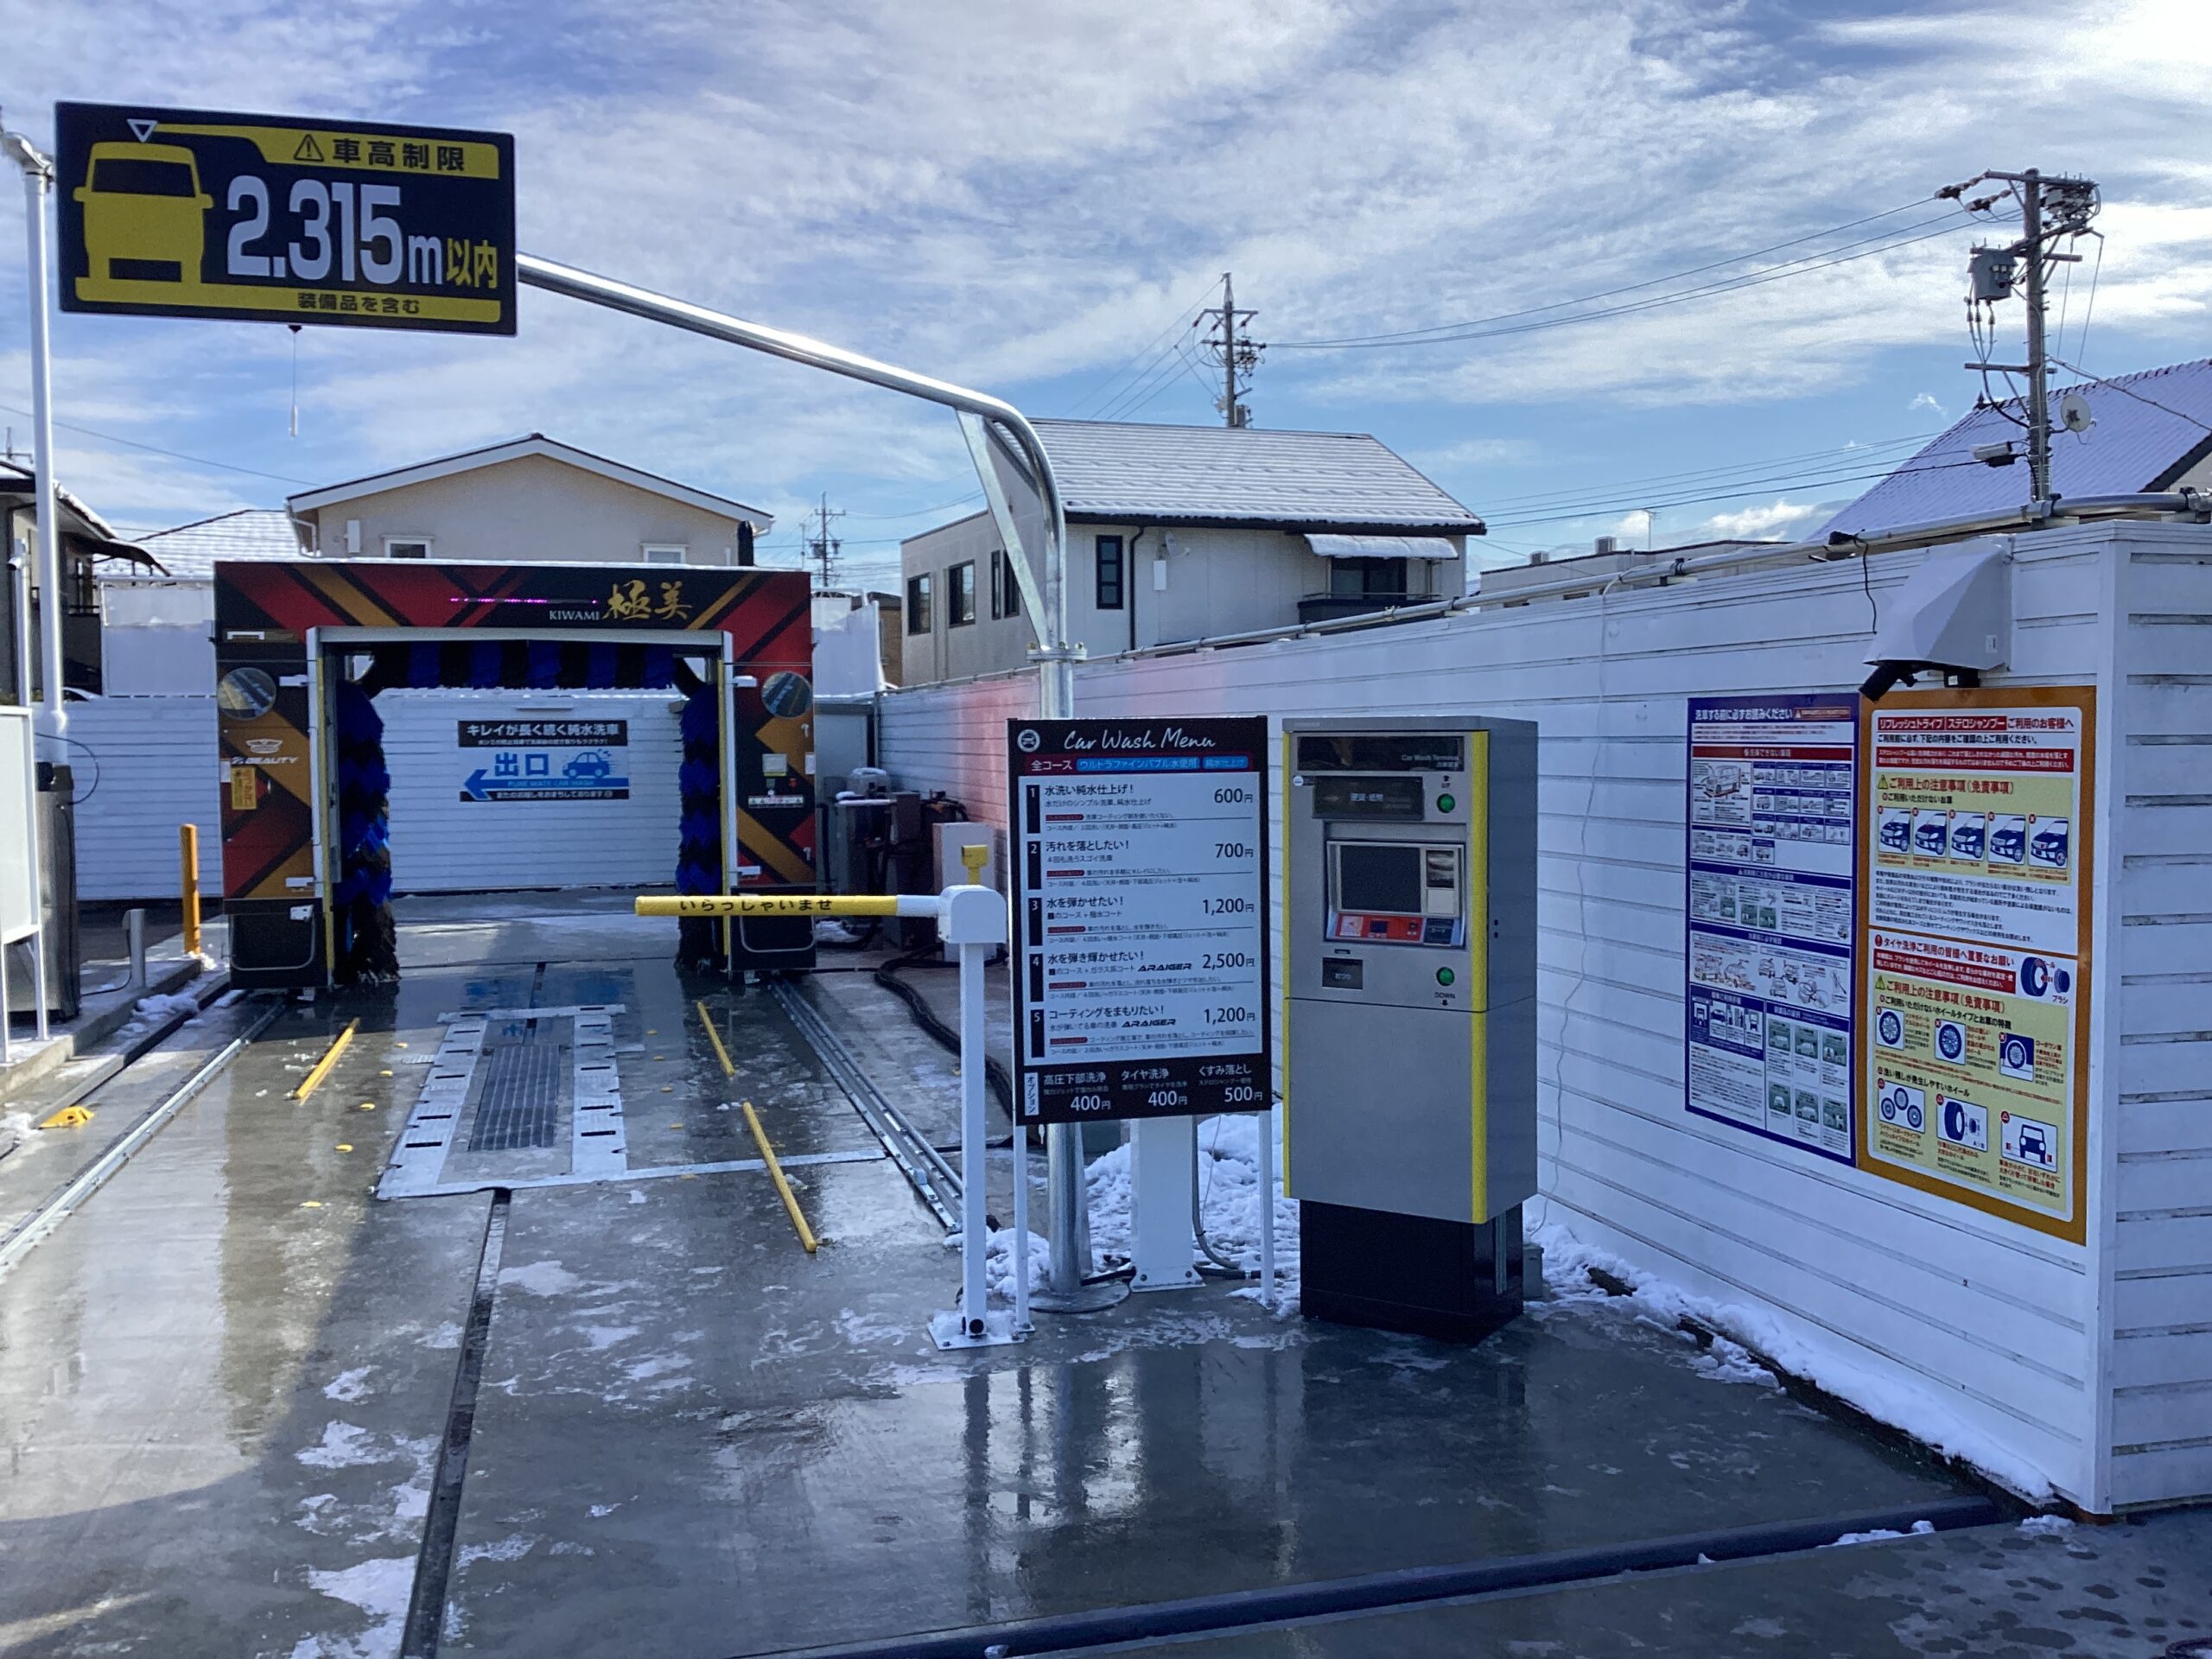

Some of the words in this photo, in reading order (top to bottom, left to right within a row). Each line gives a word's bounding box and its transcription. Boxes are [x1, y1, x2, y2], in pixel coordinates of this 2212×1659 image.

[332, 139, 466, 171] 車高制限
[297, 293, 420, 315] 装備品を含む
[602, 579, 692, 620] 極美
[549, 610, 601, 621] KIWAMI
[1063, 730, 1096, 750] Car
[1101, 728, 1156, 750] Wash
[1160, 727, 1217, 749] Menu
[494, 752, 550, 777] 出口
[1030, 759, 1073, 772] 全コース
[1029, 787, 1036, 798] 1
[1213, 788, 1254, 804] 600円
[1030, 843, 1038, 855] 2
[1214, 842, 1254, 859] 700円
[679, 899, 834, 912] いらっしゃいませ
[1031, 899, 1039, 911] 3
[1202, 898, 1255, 914] 1,200円
[1032, 957, 1040, 968] 4
[1202, 953, 1255, 969] 2,500円
[1136, 963, 1192, 972] ARAIGER
[1433, 991, 1456, 1000] DOWN
[1033, 1013, 1041, 1023] 5
[1204, 1007, 1255, 1025] 1,200円
[1121, 1018, 1176, 1028] ARAIGER
[1121, 1069, 1169, 1081] タイヤ洗浄
[1198, 1064, 1252, 1077] くすみ落とし
[1147, 1091, 1188, 1107] 400円
[1224, 1086, 1263, 1103] 500円
[1070, 1095, 1111, 1111] 400円
